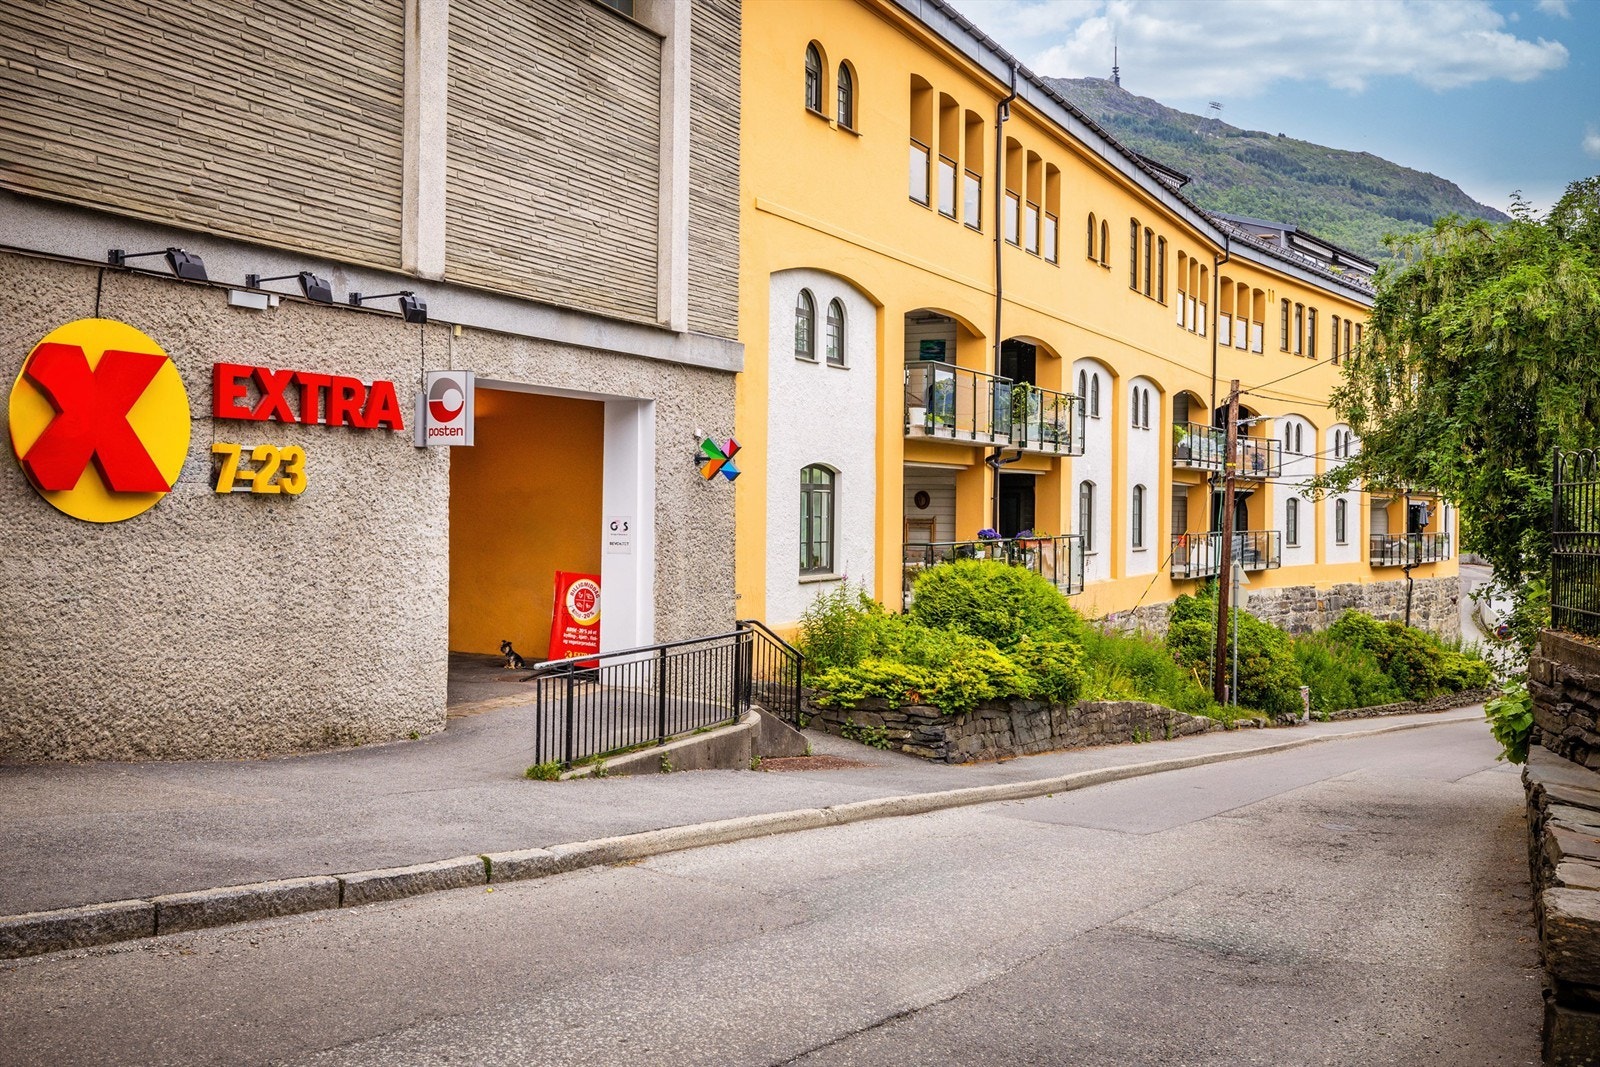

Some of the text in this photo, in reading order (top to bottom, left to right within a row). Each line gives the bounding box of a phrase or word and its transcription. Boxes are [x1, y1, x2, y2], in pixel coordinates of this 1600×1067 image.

[213, 362, 405, 430] EXTRA
[428, 425, 463, 439] posten
[212, 443, 307, 495] 7-23
